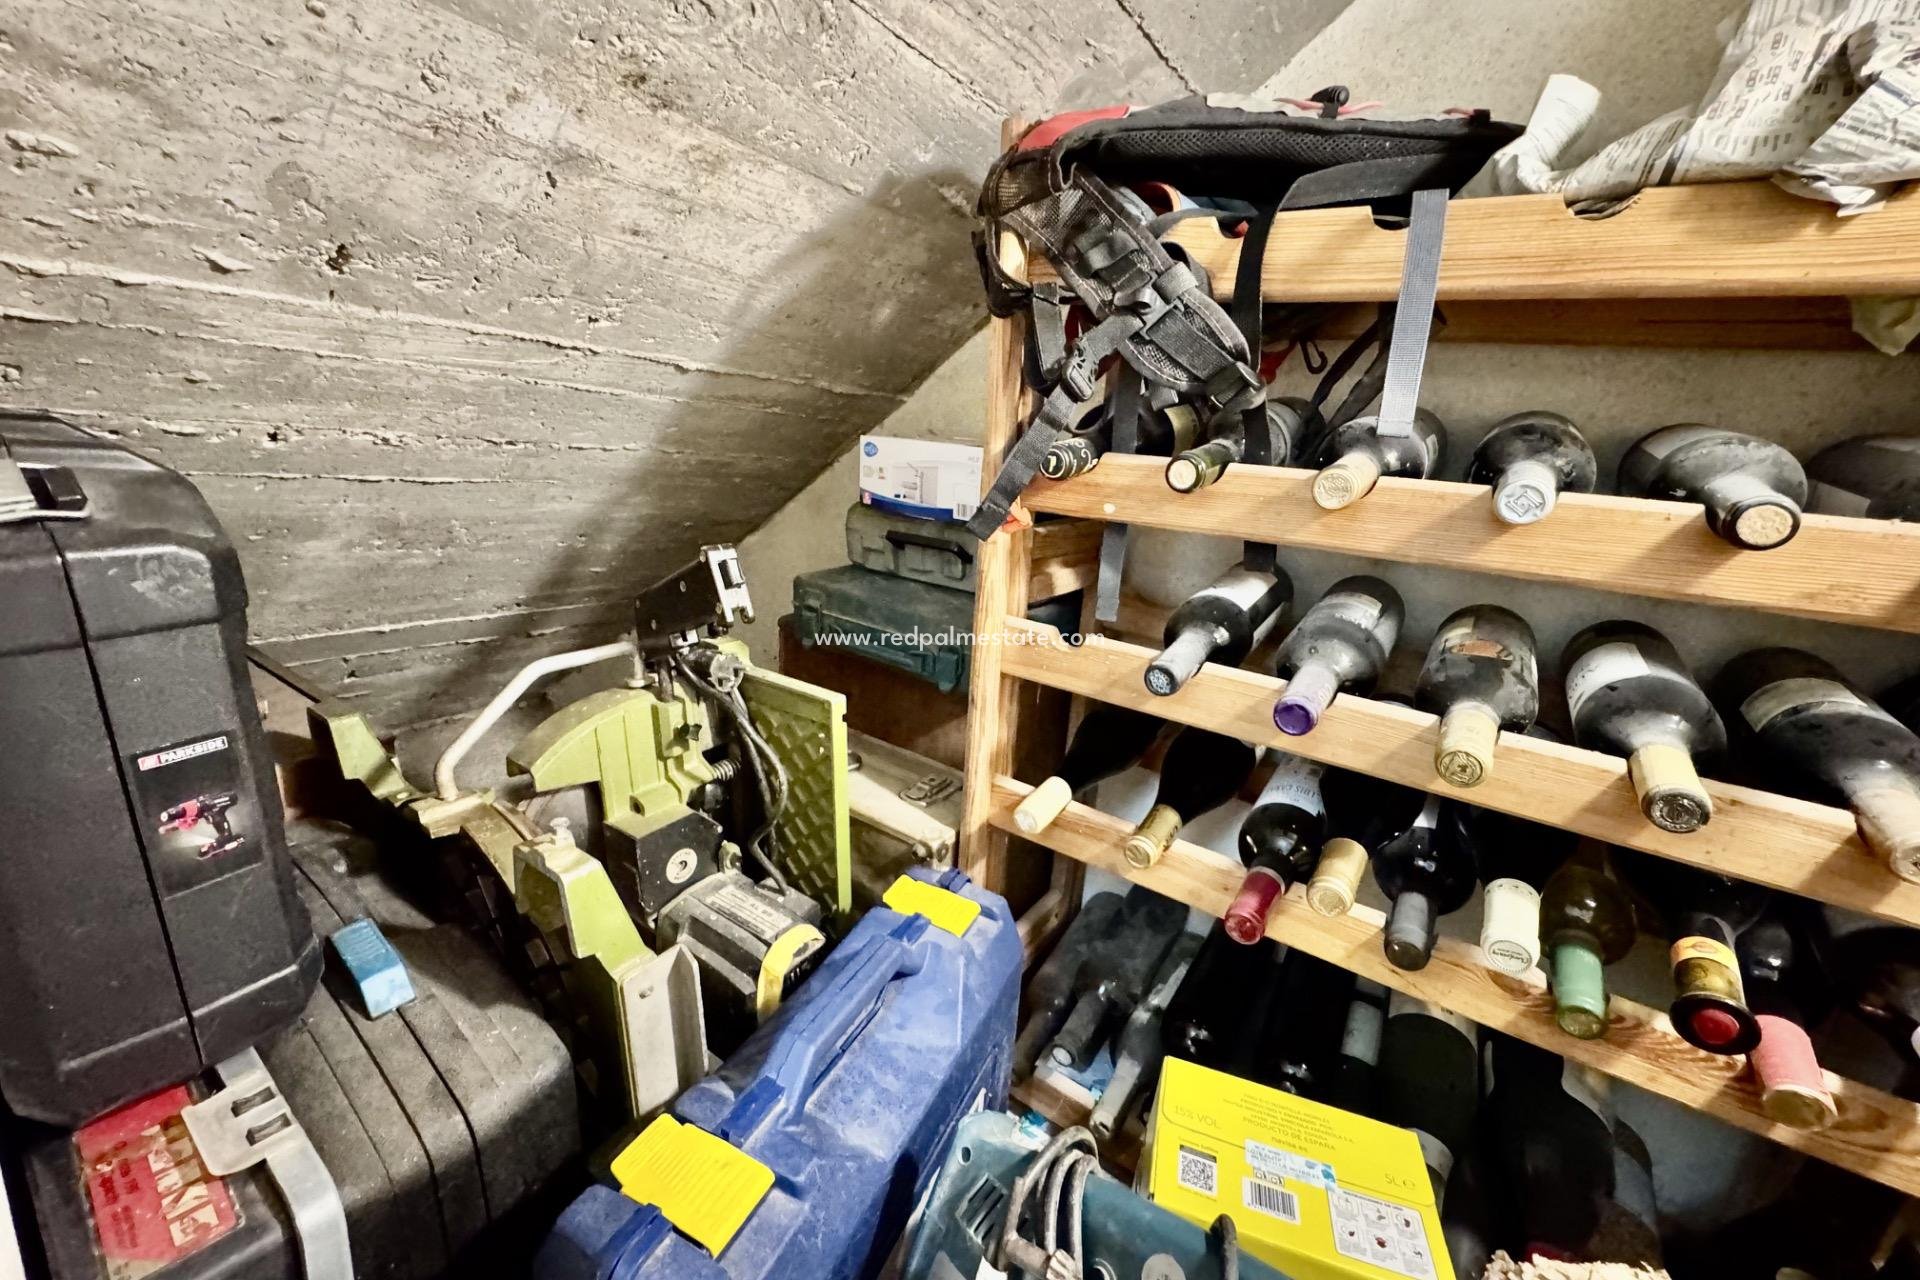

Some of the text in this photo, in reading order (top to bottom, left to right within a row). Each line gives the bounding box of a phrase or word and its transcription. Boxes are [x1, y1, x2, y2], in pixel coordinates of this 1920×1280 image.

[160, 738, 226, 763] PARKSIDE
[1174, 1105, 1194, 1120] 15%
[1241, 1115, 1289, 1136] PRODUCTO
[1290, 1131, 1303, 1141] DE
[1304, 1136, 1336, 1151] ESPAÑA
